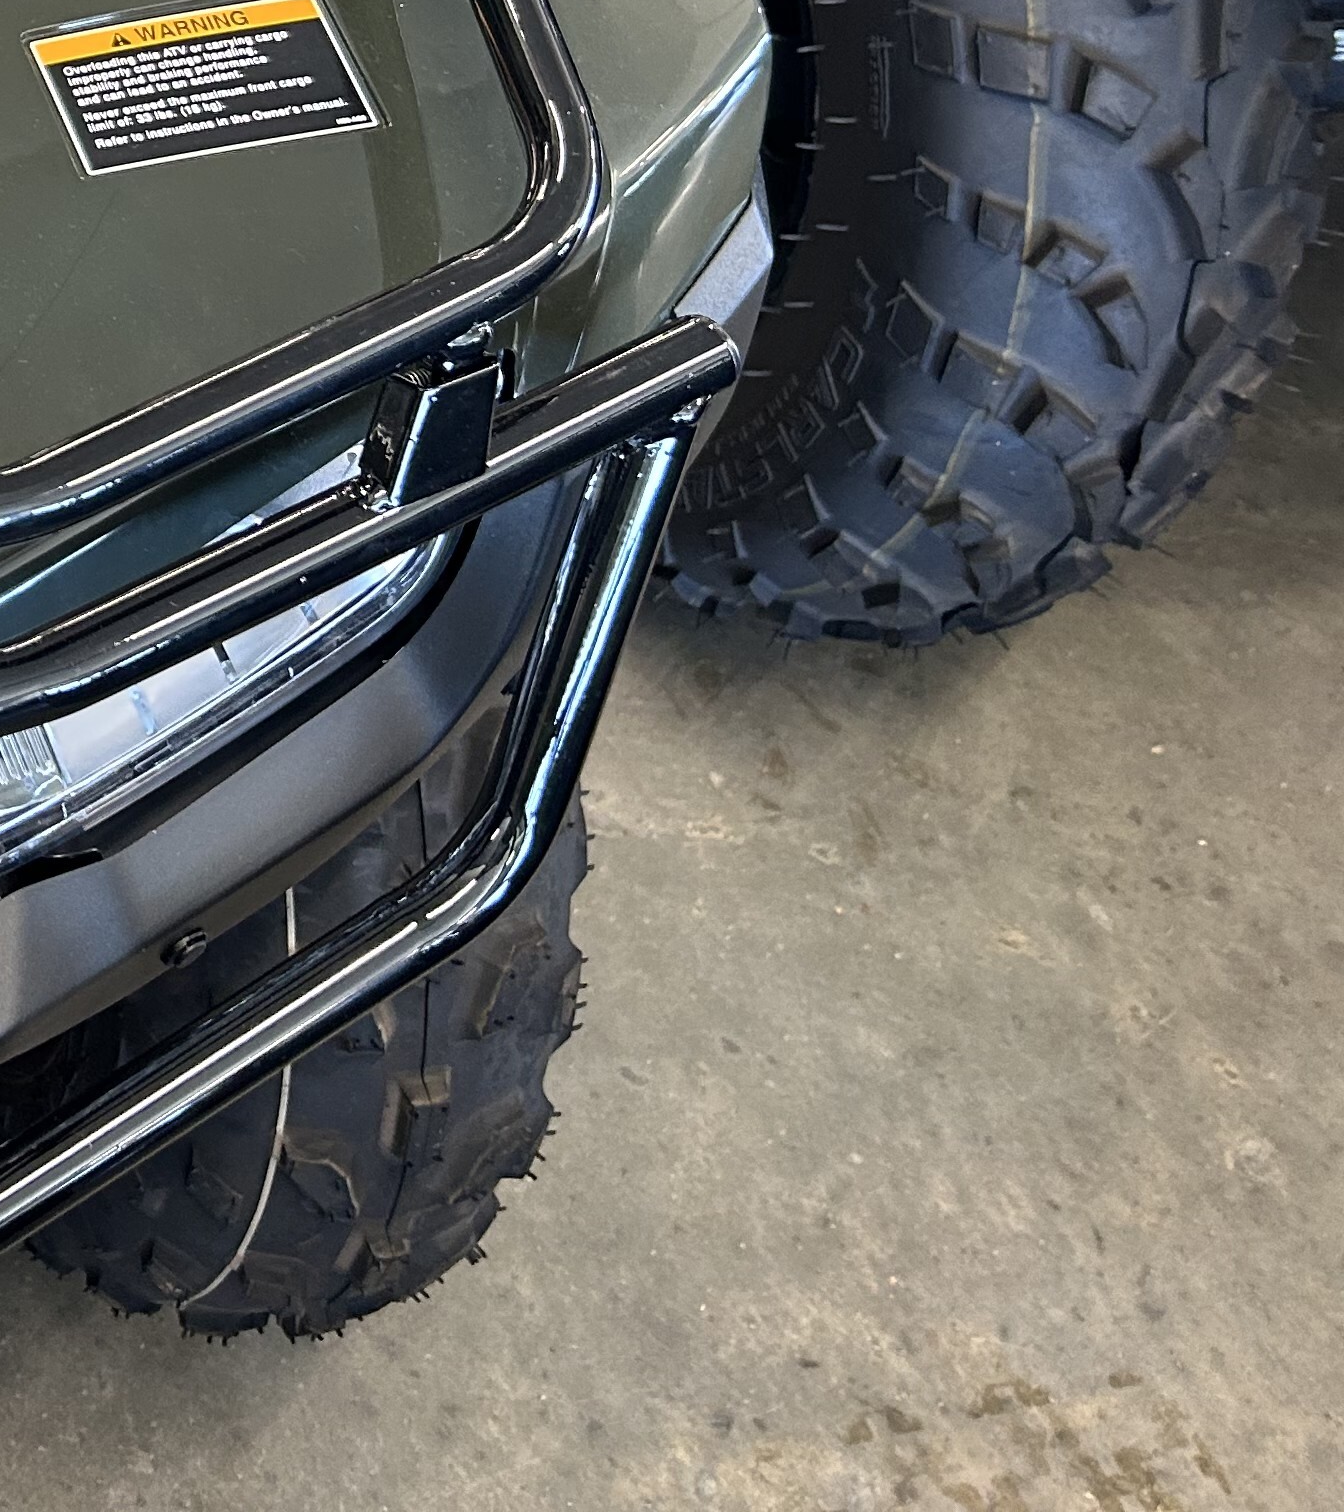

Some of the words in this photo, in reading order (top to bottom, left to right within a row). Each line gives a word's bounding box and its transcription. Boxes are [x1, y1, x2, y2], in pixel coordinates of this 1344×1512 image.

[135, 11, 248, 40] WARNING
[62, 55, 137, 77] Overloading
[136, 50, 161, 63] this
[162, 44, 188, 58] ATV
[188, 43, 203, 54] or
[204, 35, 254, 51] carrying
[254, 30, 289, 43] cargo
[66, 67, 132, 87] improperly
[132, 62, 157, 74] can
[157, 54, 202, 70] change
[71, 80, 121, 97] stability
[121, 74, 147, 88] and
[146, 67, 194, 83] braking
[193, 55, 269, 76] performance
[76, 93, 102, 107] and
[102, 90, 126, 102] can
[126, 83, 156, 98] lead
[154, 82, 171, 93] to
[171, 79, 188, 90] an
[189, 69, 244, 87] accident.
[82, 108, 120, 123] Never
[121, 98, 166, 116] exceed
[166, 95, 189, 107] the
[189, 86, 247, 103] maximum
[246, 79, 278, 93] front
[278, 75, 314, 88] cargo
[86, 119, 116, 133] limit
[94, 135, 129, 149] Refer
[129, 132, 146, 143] to
[145, 119, 216, 140] instructions
[214, 116, 230, 127] in
[229, 113, 252, 125] the
[301, 97, 349, 113] manual.
